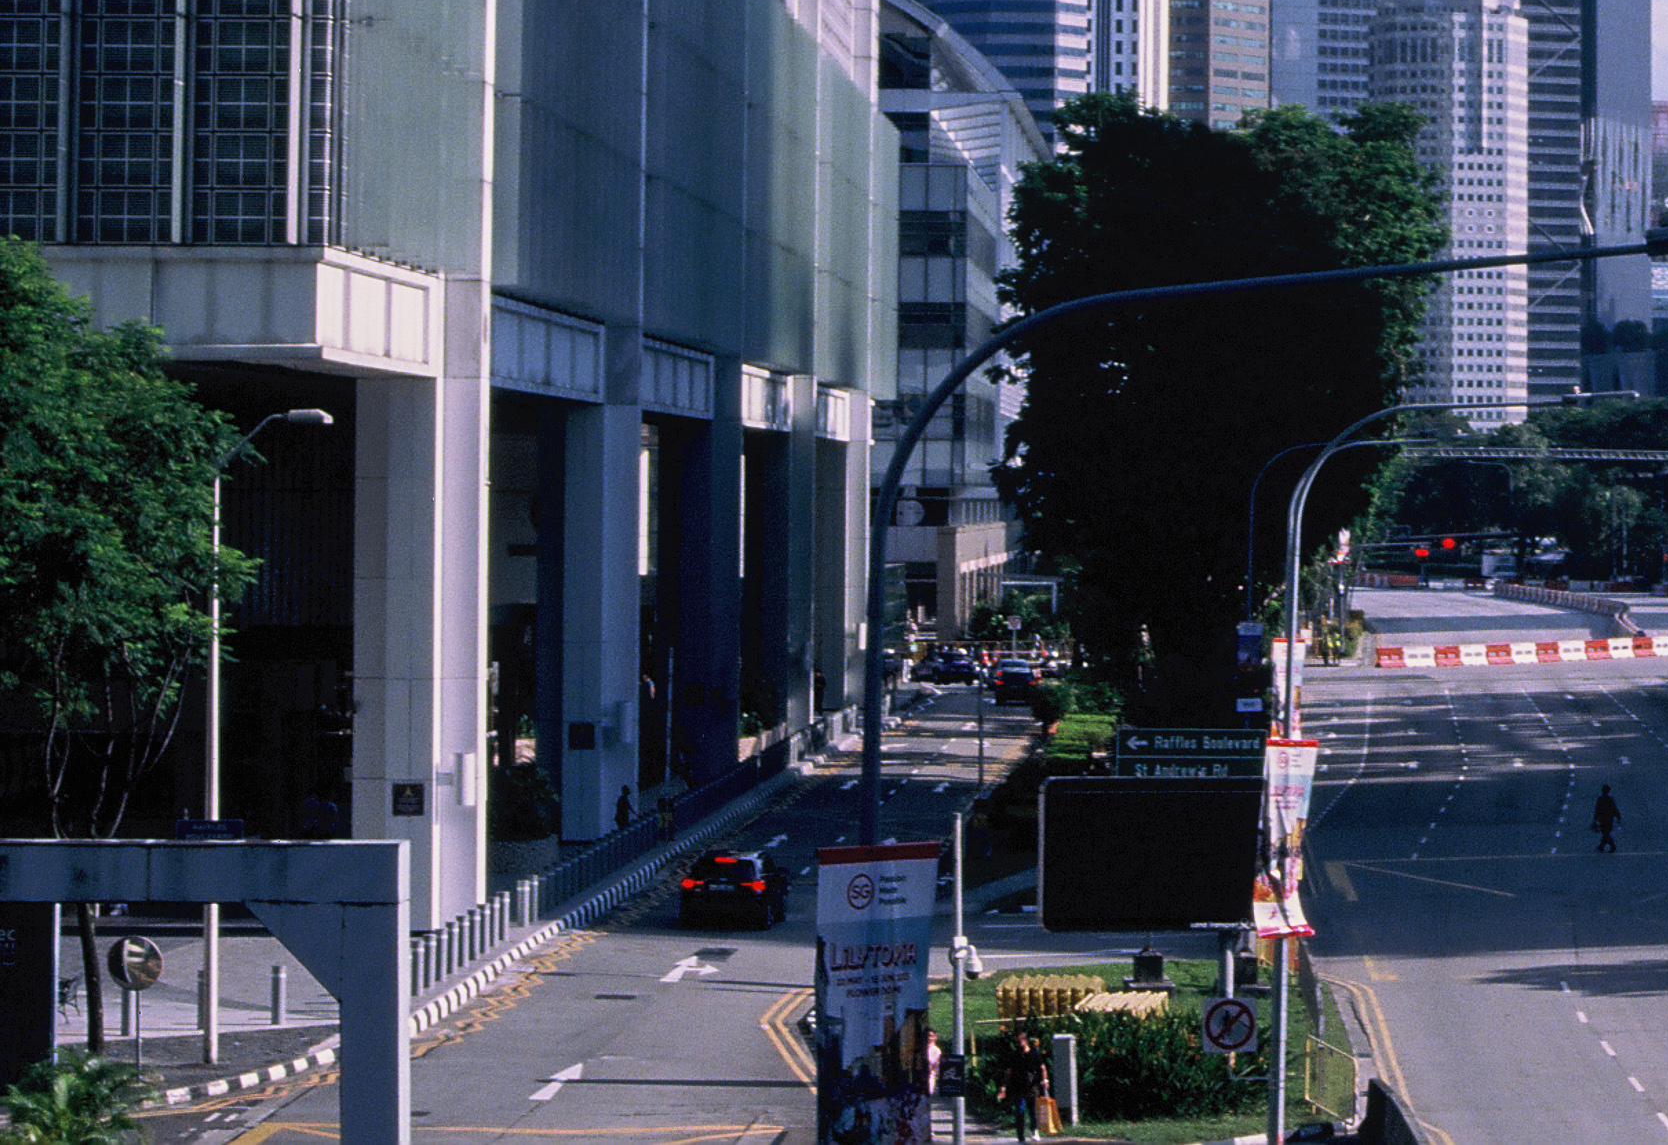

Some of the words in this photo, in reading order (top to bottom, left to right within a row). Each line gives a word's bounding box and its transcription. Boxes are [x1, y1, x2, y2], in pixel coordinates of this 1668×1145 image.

[1153, 735, 1198, 750] Raffles
[1202, 735, 1261, 750] Boulevard
[1134, 763, 1149, 777] St
[1153, 763, 1208, 777] Andrew's
[1212, 763, 1229, 777] Rd
[851, 885, 871, 899] SG
